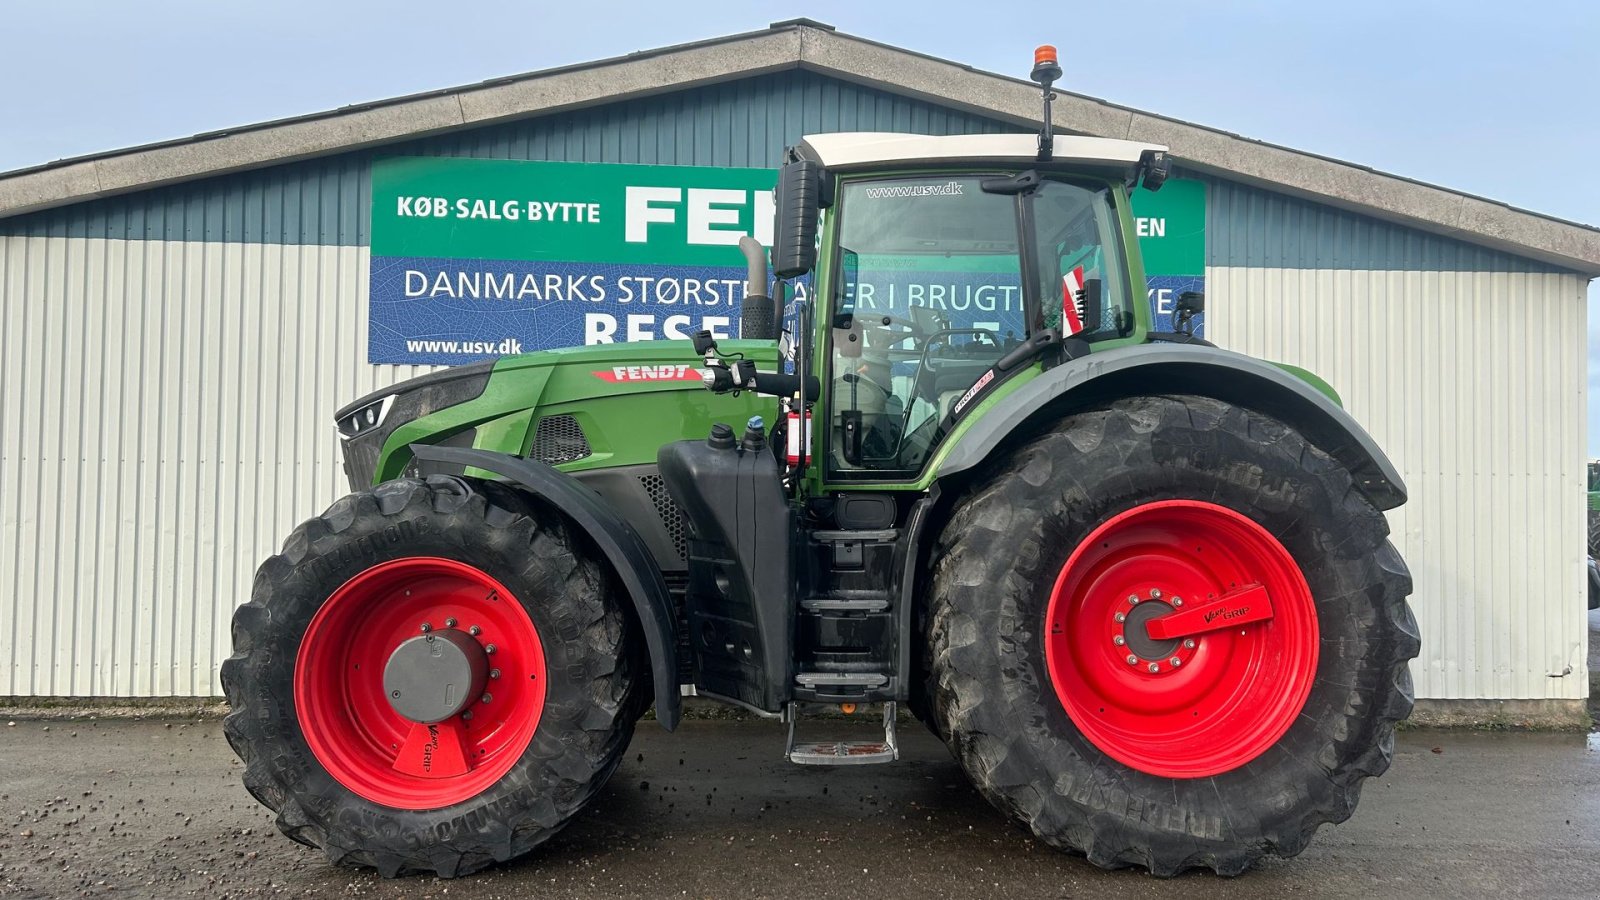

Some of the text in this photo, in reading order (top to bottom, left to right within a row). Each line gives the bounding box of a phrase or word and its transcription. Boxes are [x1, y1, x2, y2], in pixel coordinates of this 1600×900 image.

[866, 182, 963, 198] www.usv.dk
[1133, 217, 1166, 237] EN
[405, 270, 606, 301] DANMARKS
[889, 283, 894, 309] I
[585, 313, 742, 345] RESE
[407, 339, 521, 355] www.usv.dk
[612, 364, 690, 380] FENDT
[1223, 606, 1250, 620] GRIP
[423, 743, 433, 773] GRIP
